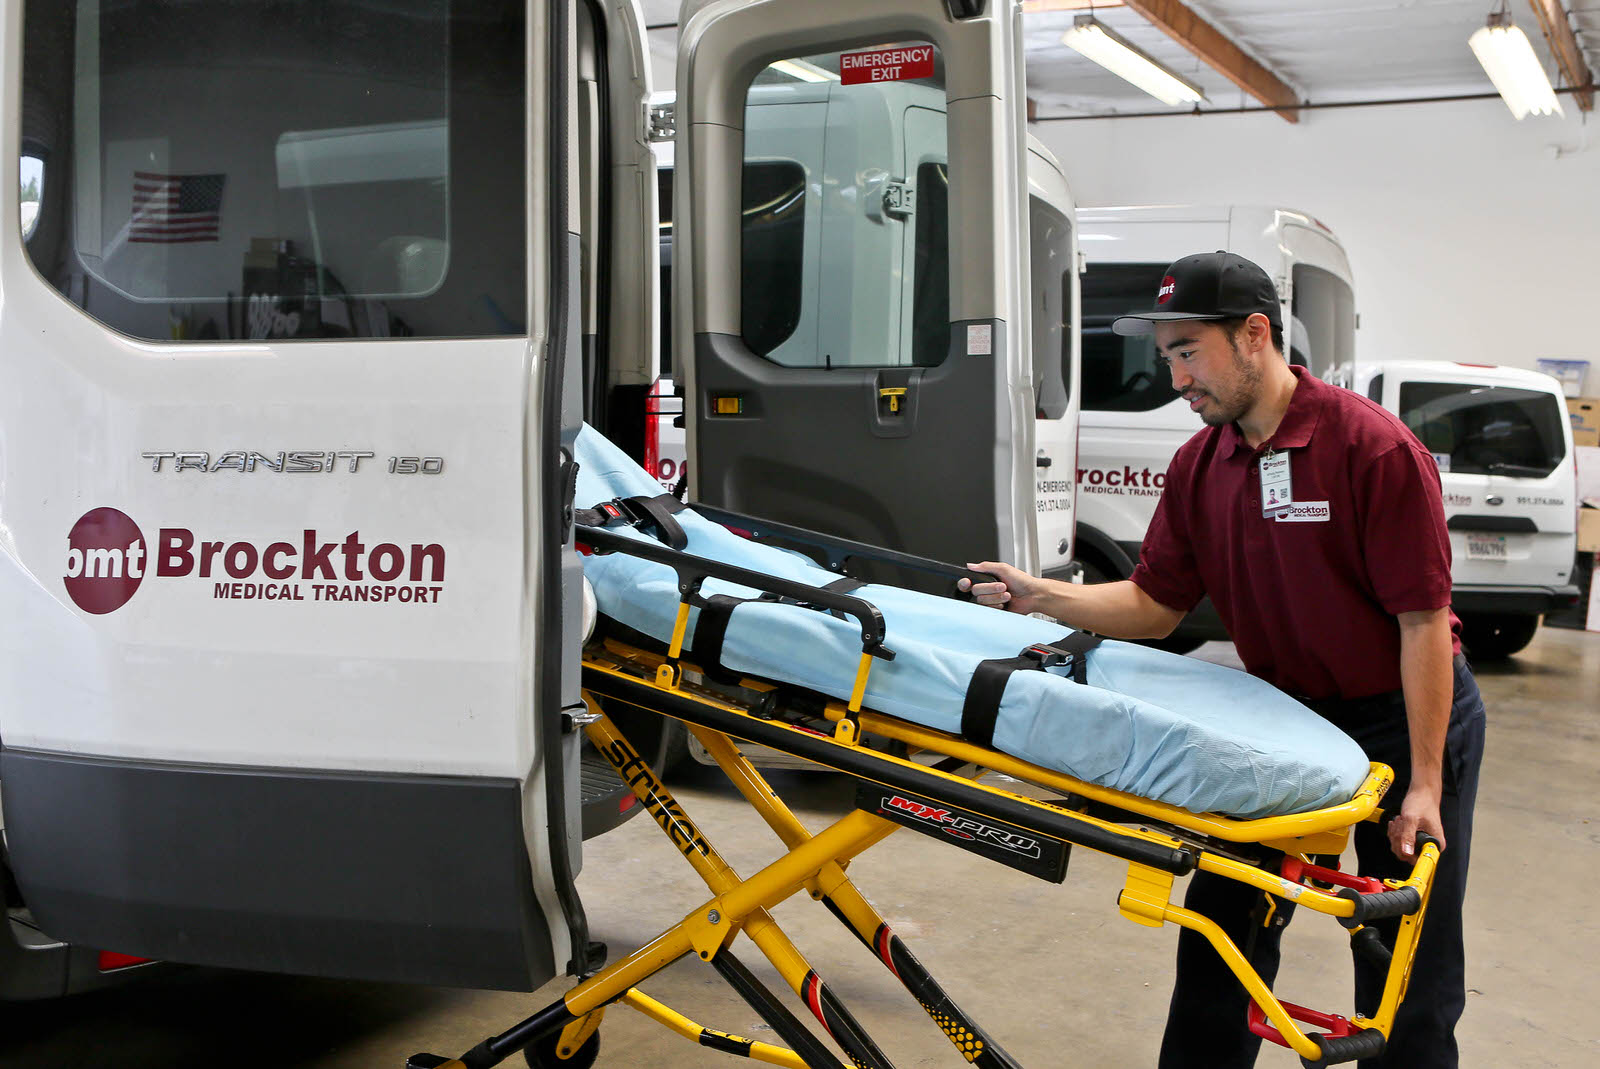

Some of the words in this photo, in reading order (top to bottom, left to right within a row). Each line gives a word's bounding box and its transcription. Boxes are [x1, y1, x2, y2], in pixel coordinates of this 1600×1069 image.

[842, 48, 931, 69] EMERGENCY
[871, 66, 902, 81] EXIT
[141, 450, 375, 473] TRANSIT
[387, 455, 444, 474] 150
[1083, 485, 1125, 495] MEDICAL
[1128, 488, 1162, 497] TRANS
[63, 537, 144, 579] bmt
[155, 527, 446, 582] Brockton
[213, 582, 304, 601] MEDICAL
[311, 584, 443, 603] TRANSPORT
[600, 739, 710, 857] stryker
[887, 795, 1037, 850] MX-PRO
